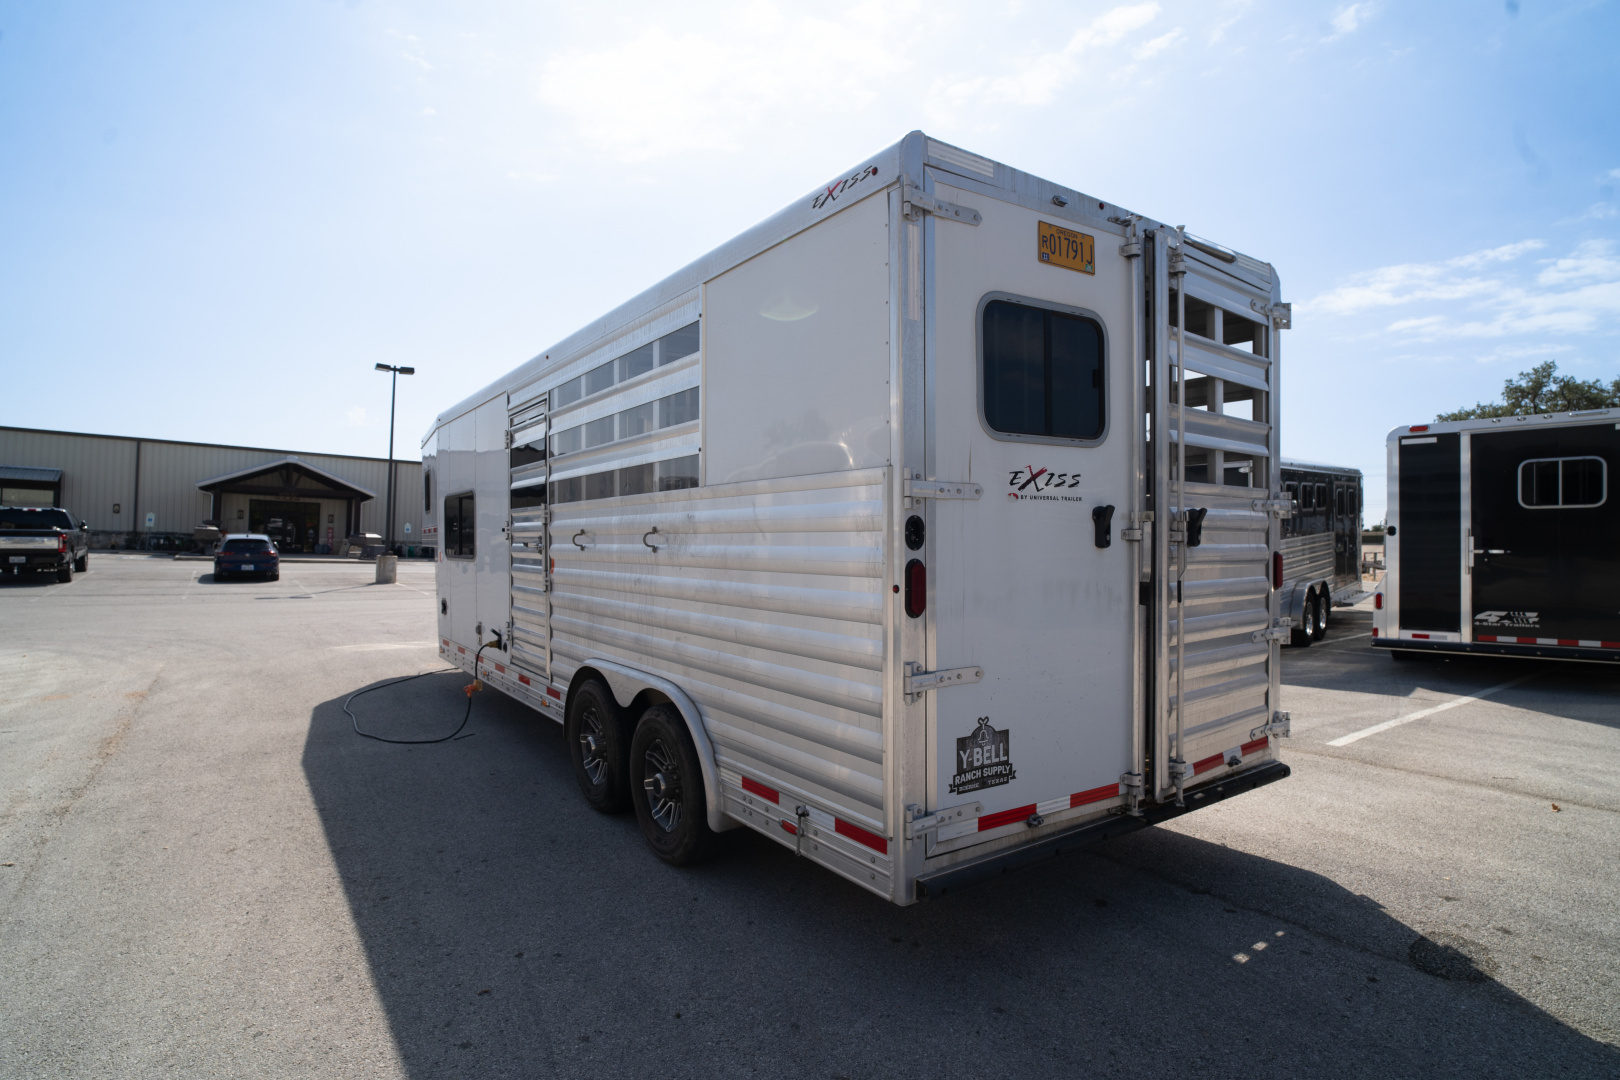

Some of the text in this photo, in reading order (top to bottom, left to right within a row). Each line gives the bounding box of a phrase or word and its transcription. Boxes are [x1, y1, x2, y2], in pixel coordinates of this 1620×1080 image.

[811, 165, 873, 209] EXISS
[1056, 228, 1078, 239] OREGON
[1009, 464, 1081, 492] EXISS
[959, 742, 1008, 769] Y-BELL
[954, 764, 1011, 786] RANCH SUPPLY
[987, 776, 1008, 785] TEXAS
